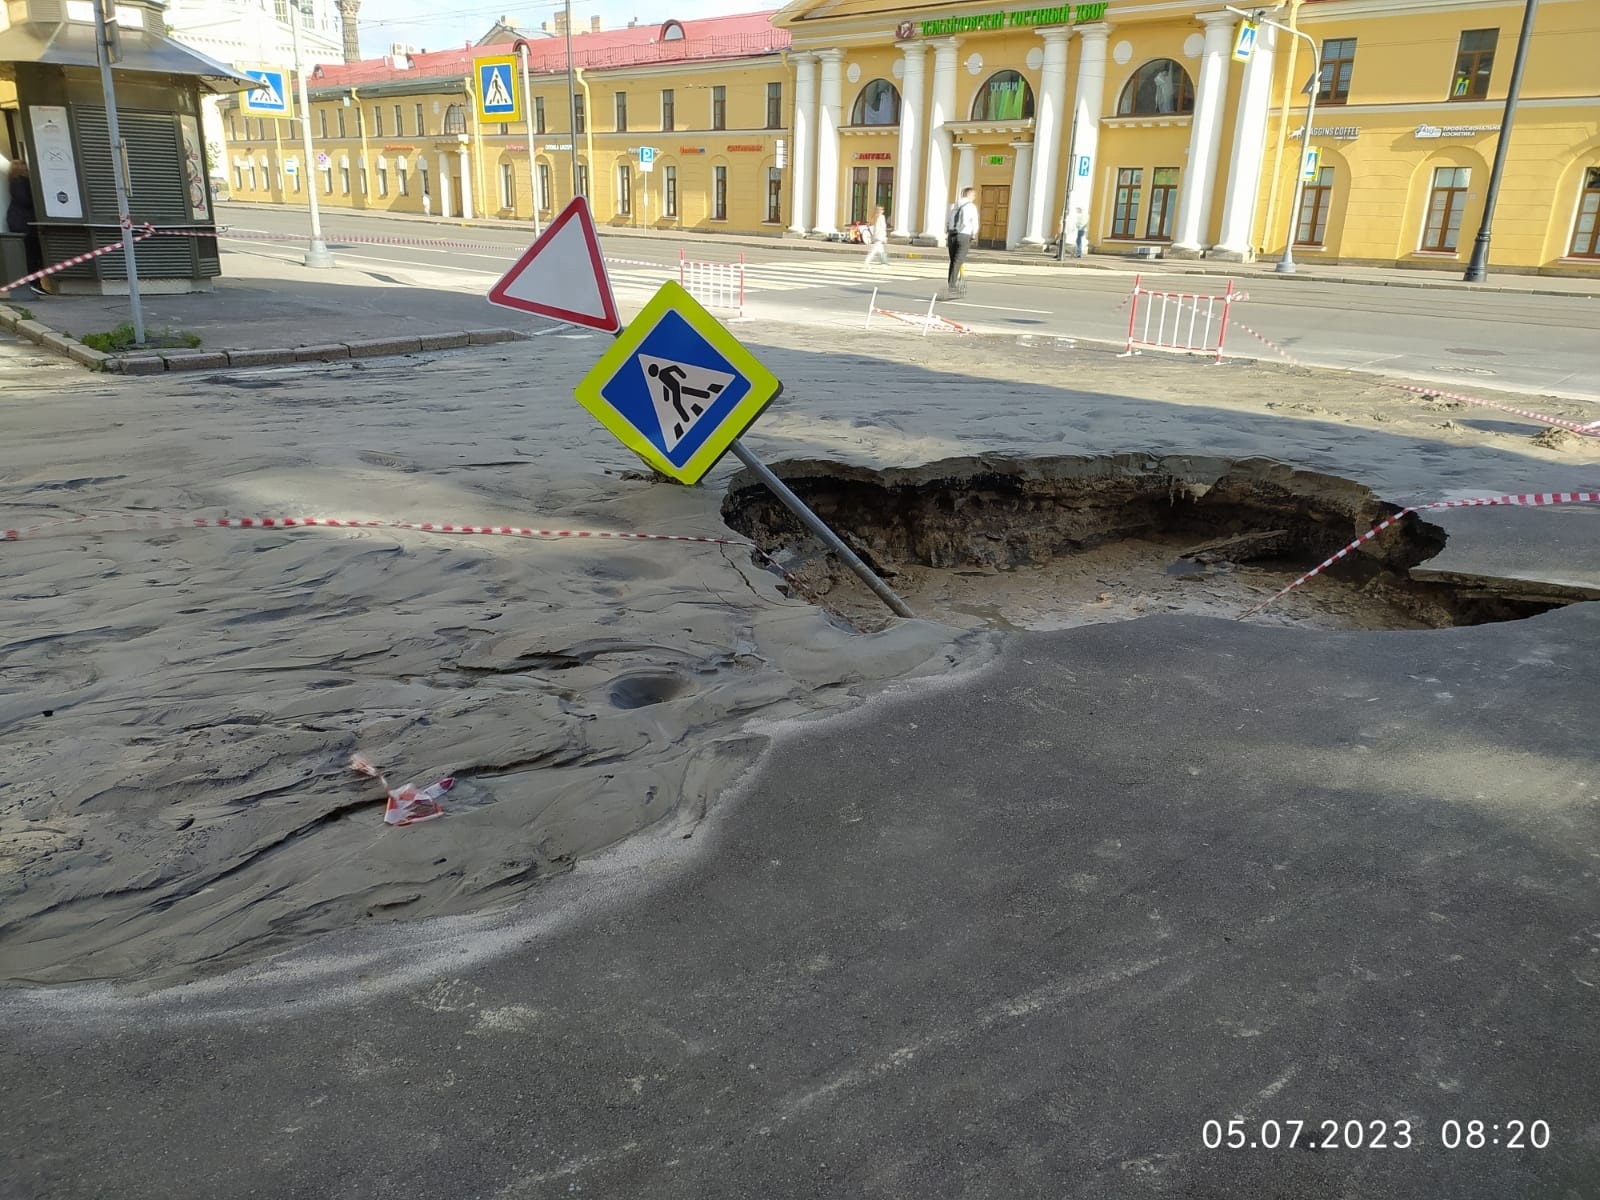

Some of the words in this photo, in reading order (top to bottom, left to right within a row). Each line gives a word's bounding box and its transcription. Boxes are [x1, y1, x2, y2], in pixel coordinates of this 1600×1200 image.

[1008, 3, 1070, 26] ГОСТИНЫЙ
[1075, 1, 1108, 23] ДВОР
[1309, 127, 1334, 136] AGGINS
[1334, 127, 1360, 136] COFFEE
[1442, 125, 1501, 133] ПРОФЕССИОНАЛЬНА
